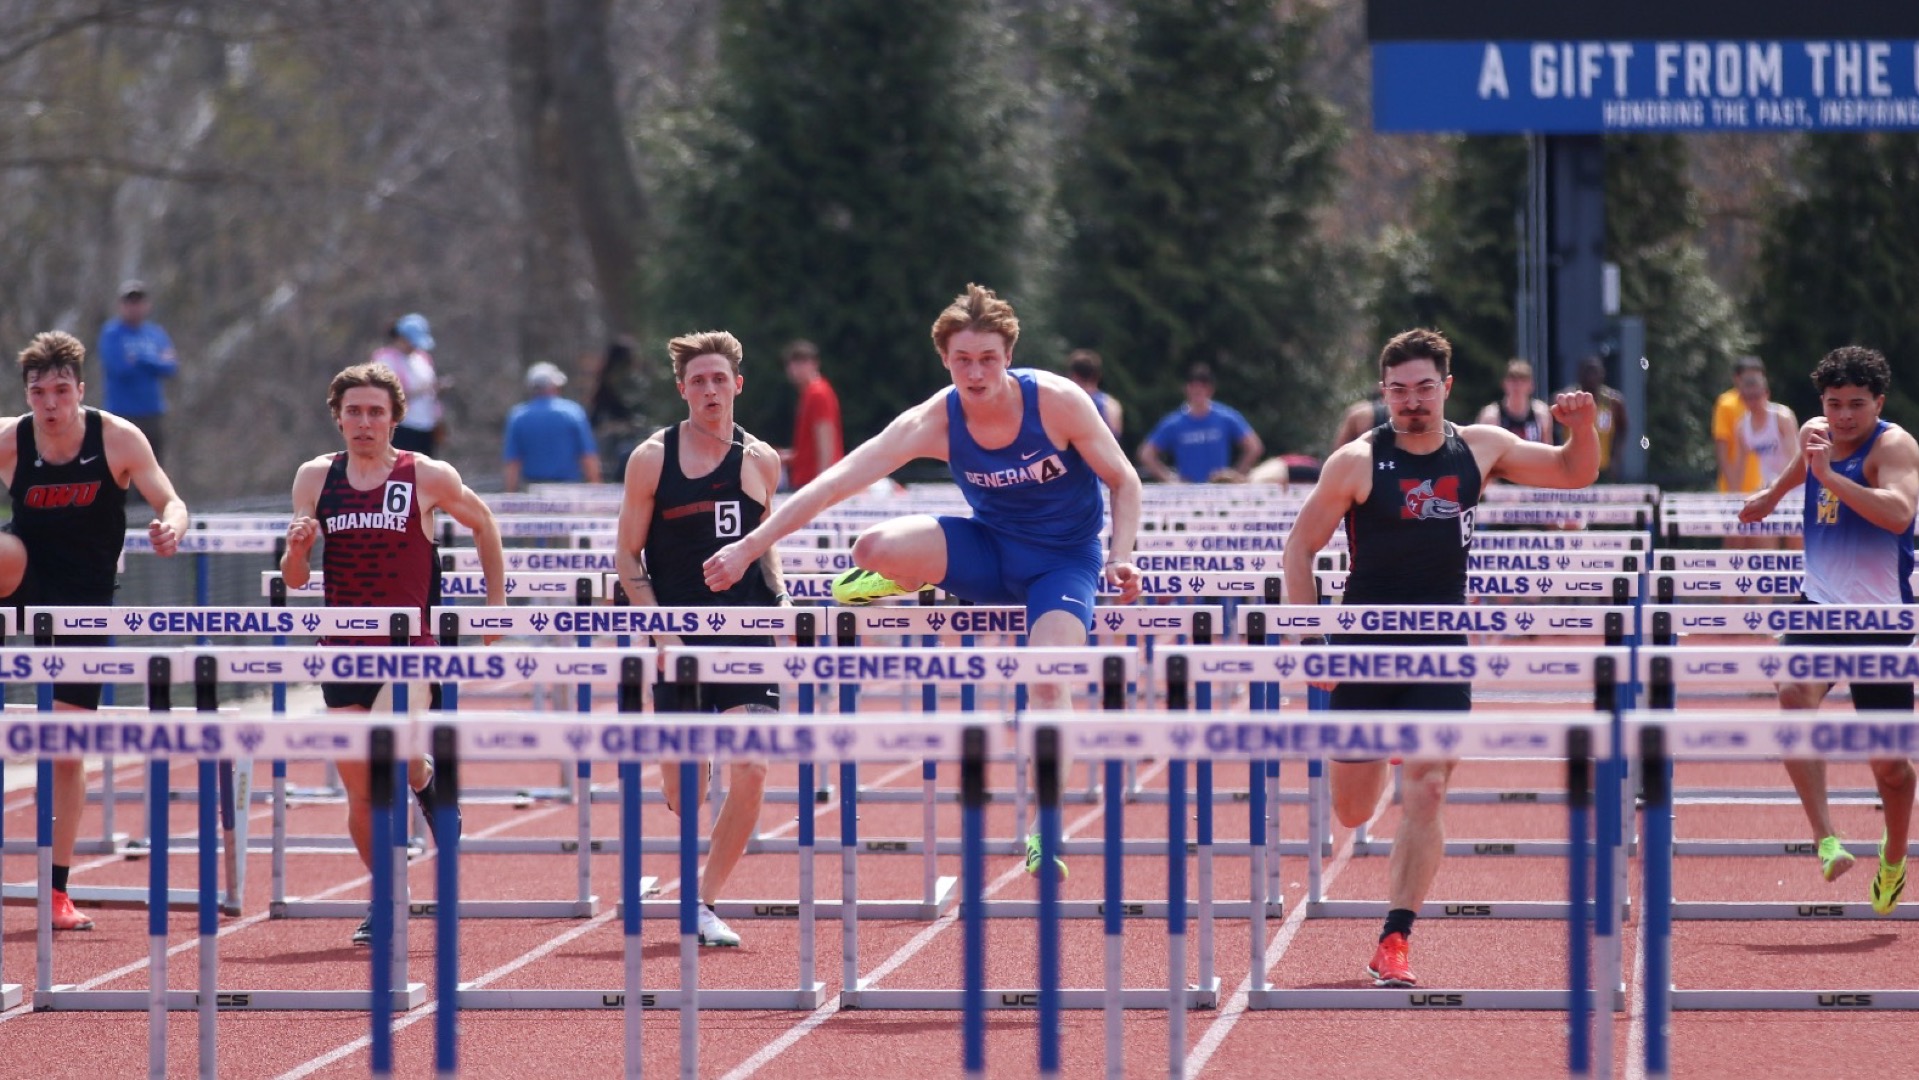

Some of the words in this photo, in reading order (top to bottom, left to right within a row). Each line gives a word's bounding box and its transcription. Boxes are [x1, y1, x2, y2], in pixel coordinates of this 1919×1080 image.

[1478, 43, 1510, 99] A
[1530, 42, 1635, 99] GIFT
[1656, 42, 1783, 98] FROM
[1806, 42, 1892, 98] THE
[1712, 101, 1748, 126] THE
[965, 466, 1036, 488] GENERAL
[1041, 459, 1060, 482] 4
[24, 481, 101, 508] OWU
[387, 484, 407, 513] 6
[326, 512, 407, 534] ROANOKE
[719, 504, 737, 535] 5
[1463, 510, 1474, 542] 3
[1137, 557, 1244, 570] GENERALS
[1469, 556, 1549, 570] NERALS
[1748, 555, 1804, 571] GENE
[529, 583, 566, 591] UCS
[1218, 582, 1254, 590] UCS
[1469, 576, 1529, 594] RALS
[1566, 582, 1603, 590] UCS
[1683, 581, 1721, 590] UCS
[64, 618, 107, 628] UCS
[148, 612, 293, 632] GENERALS
[336, 619, 378, 629] UCS
[471, 619, 513, 627] UCS
[554, 612, 698, 632] GENERALS
[741, 619, 784, 628] UCS
[867, 618, 910, 628] UCS
[1139, 618, 1181, 627] UCS
[1277, 618, 1320, 626] UCS
[1361, 611, 1506, 631] GENERALS
[1550, 618, 1593, 628] UCS
[1683, 617, 1726, 626] UCS
[1768, 610, 1914, 630] GENERALS
[83, 663, 134, 674] UCS
[231, 662, 282, 673] UCS
[332, 655, 504, 678] GENERALS
[556, 664, 607, 675] UCS
[713, 663, 763, 674] UCS
[813, 655, 985, 679] GENERALS
[1037, 663, 1088, 674] UCS
[1203, 661, 1253, 672] UCS
[1304, 654, 1476, 677] GENERALS
[1529, 663, 1579, 674] UCS
[1687, 663, 1738, 674] UCS
[7, 724, 221, 753] GENERALS
[602, 726, 814, 754] GENERALS
[1205, 725, 1418, 753] GENERALS
[754, 906, 799, 916] UCS
[1445, 905, 1491, 915] UCS
[1798, 906, 1844, 916] UCS
[1410, 994, 1463, 1006] UCS
[1817, 995, 1872, 1006] UCS
